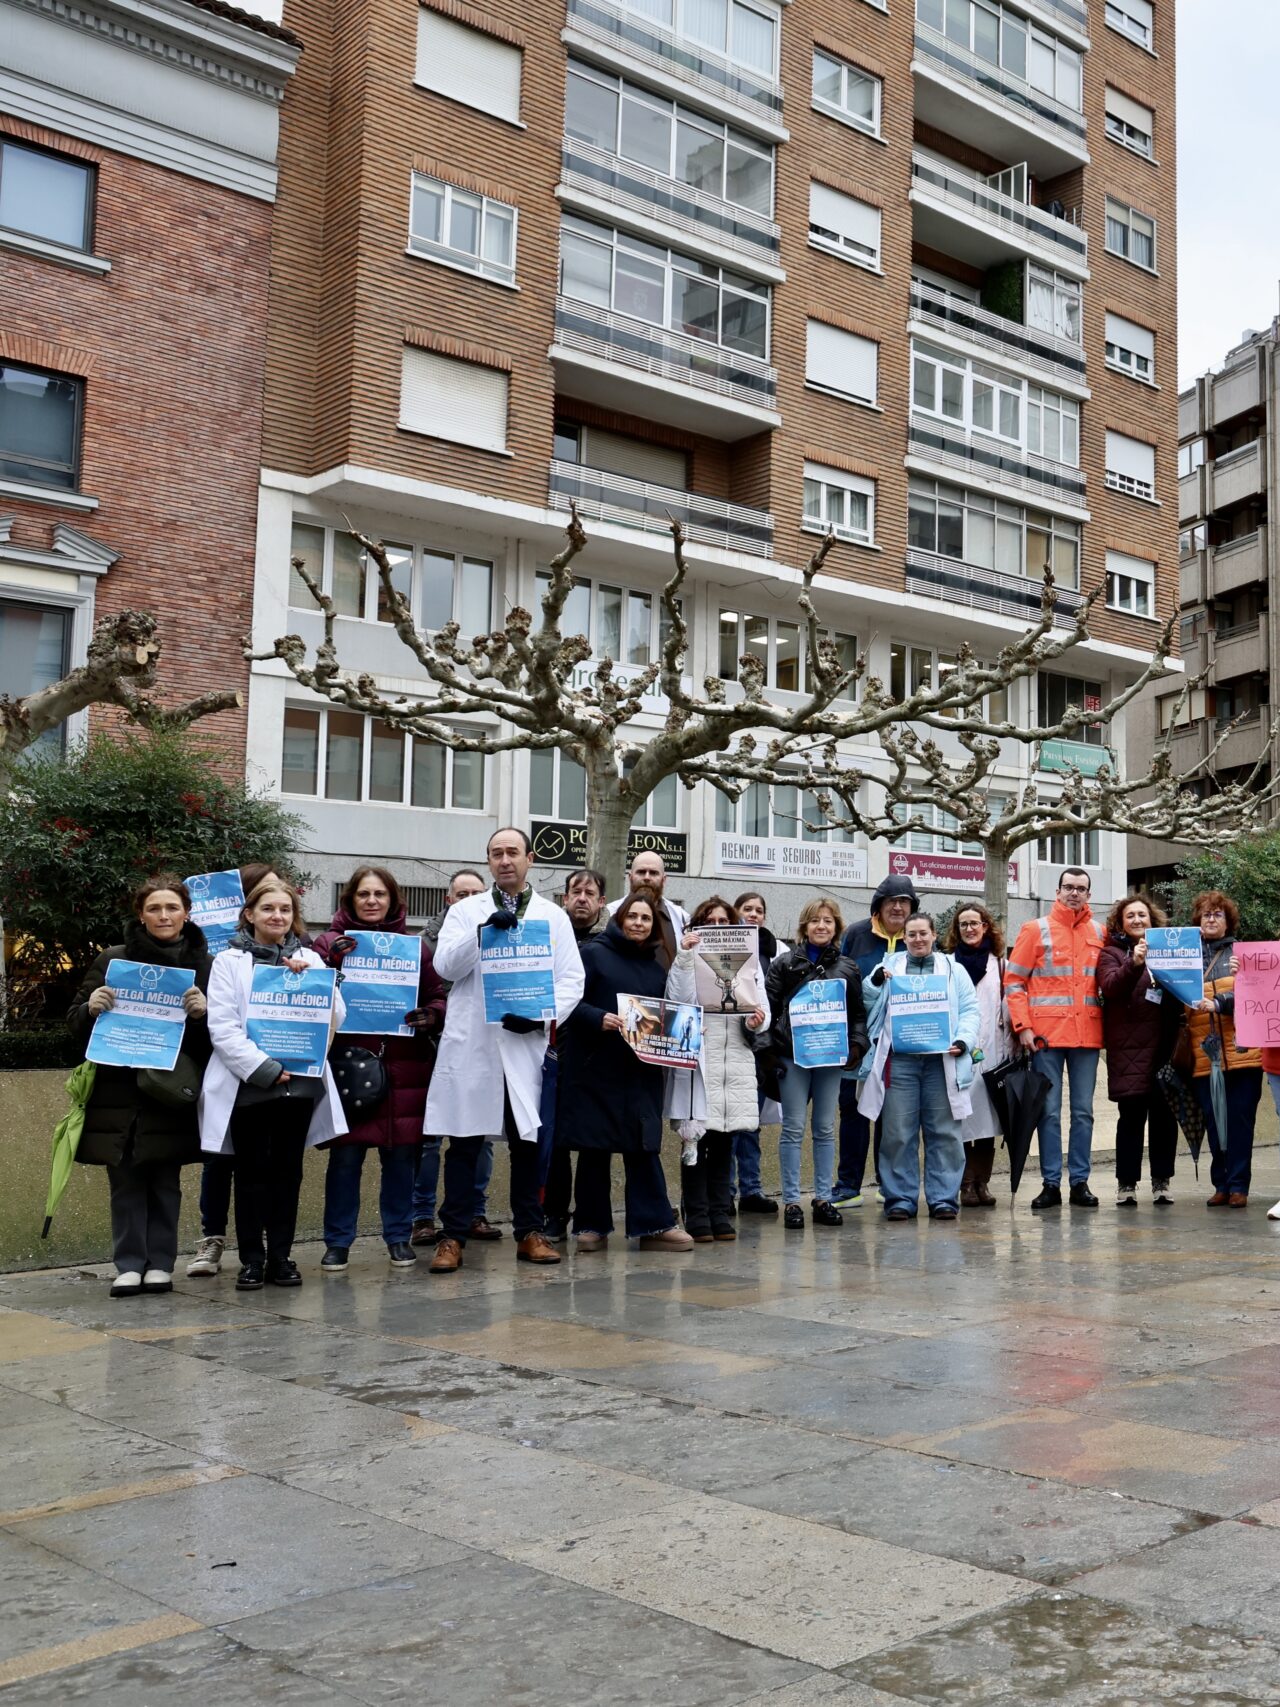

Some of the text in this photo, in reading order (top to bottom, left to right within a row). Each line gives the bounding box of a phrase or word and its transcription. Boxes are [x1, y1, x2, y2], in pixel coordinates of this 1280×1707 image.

[722, 842, 760, 860] AGENCIA
[767, 848, 776, 861] DE
[782, 847, 821, 864] SEGUROS
[782, 865, 862, 879] LEYRE CENTELLAS JUSTEL
[206, 896, 241, 910] MÉDICA
[482, 944, 549, 958] HUELGA MÉDICA
[1147, 946, 1200, 958] HUELGA MÉDICA
[344, 956, 416, 970] HUELGA MÉDICA
[251, 992, 328, 1006] HUELGA MÉDICA
[892, 990, 946, 1004] HUELGA MÉDICA
[790, 1000, 844, 1014] HUELGA MÉDICA
